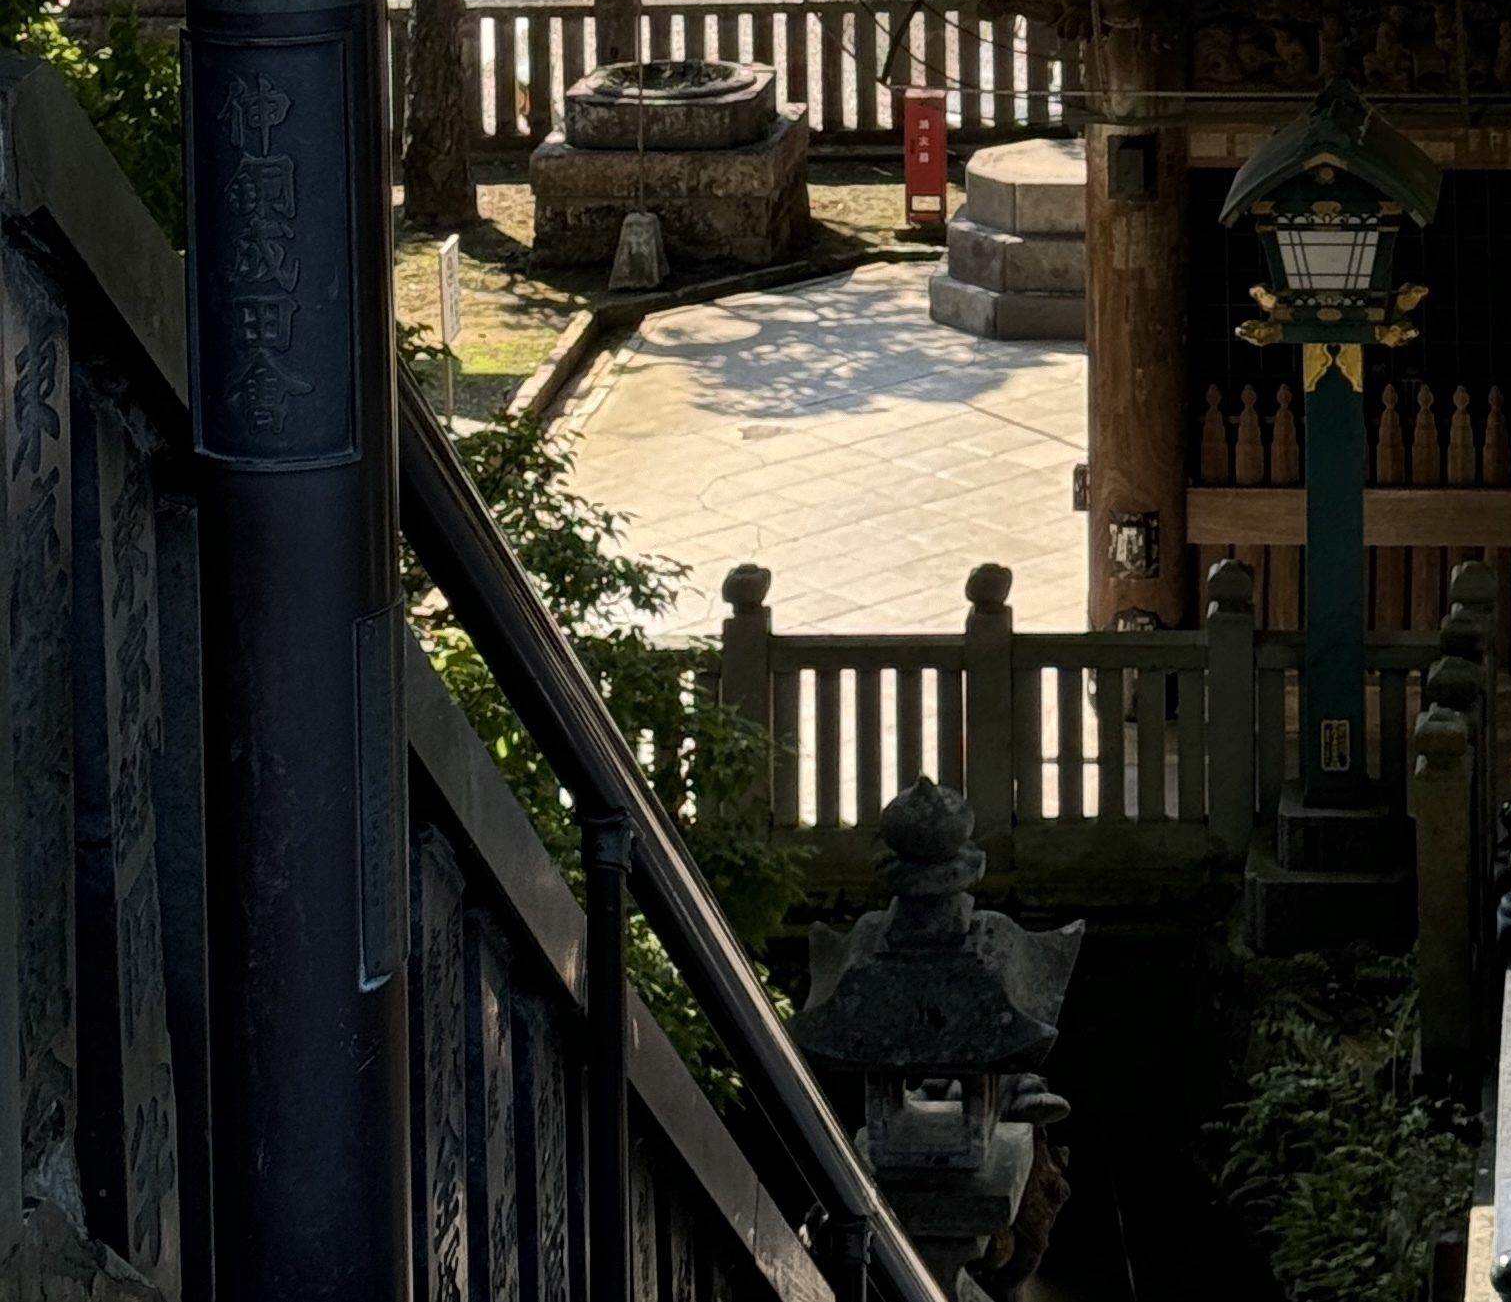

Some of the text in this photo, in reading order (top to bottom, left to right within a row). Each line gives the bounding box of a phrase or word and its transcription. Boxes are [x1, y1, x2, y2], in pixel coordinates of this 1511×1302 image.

[217, 69, 316, 437] 伸銅成田會
